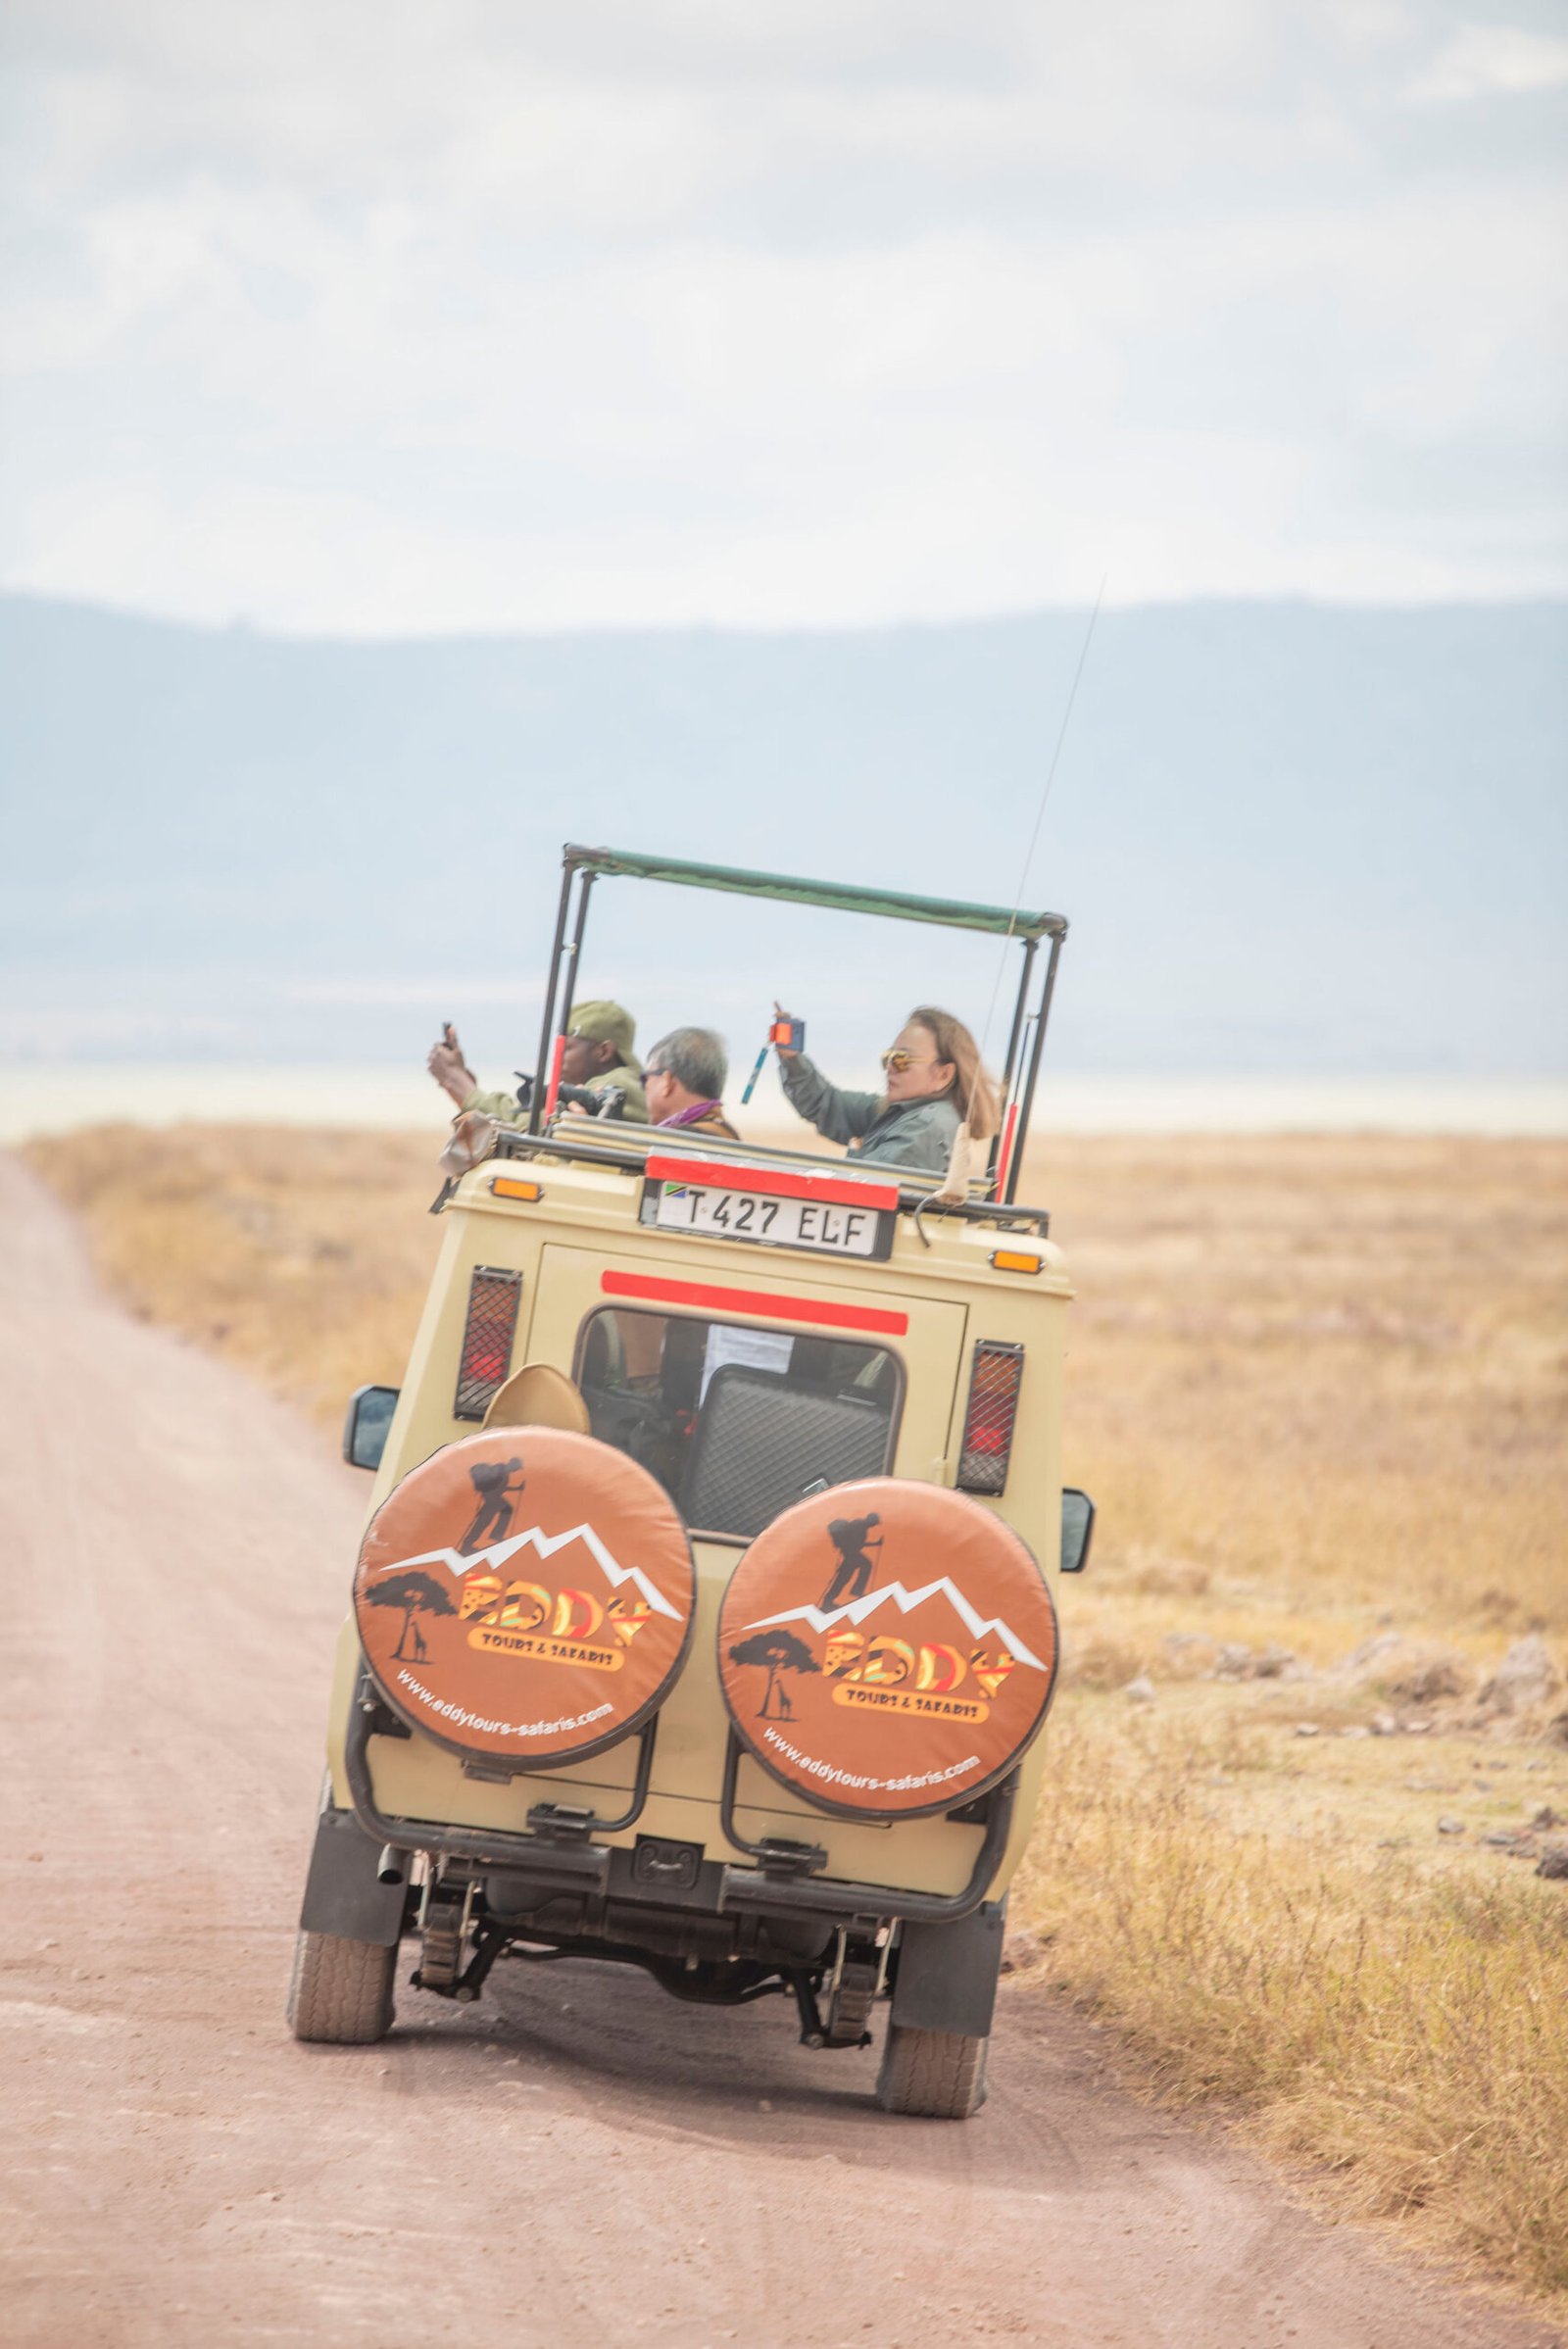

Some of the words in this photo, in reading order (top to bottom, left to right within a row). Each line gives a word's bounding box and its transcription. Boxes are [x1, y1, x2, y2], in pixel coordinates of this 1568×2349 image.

[798, 1206, 866, 1247] ELF
[458, 1572, 653, 1647] EDDY
[481, 1633, 533, 1652] TOURS
[537, 1642, 547, 1654] &
[552, 1645, 614, 1666] SAFARIS
[821, 1630, 1016, 1700] EDDY
[396, 1668, 615, 1737] www.eddytours-safaris.com
[846, 1688, 899, 1706] TOURS
[902, 1697, 911, 1709] &
[915, 1698, 979, 1719] SAFARIS
[762, 1726, 981, 1791] www.eddytours-safaris.com
